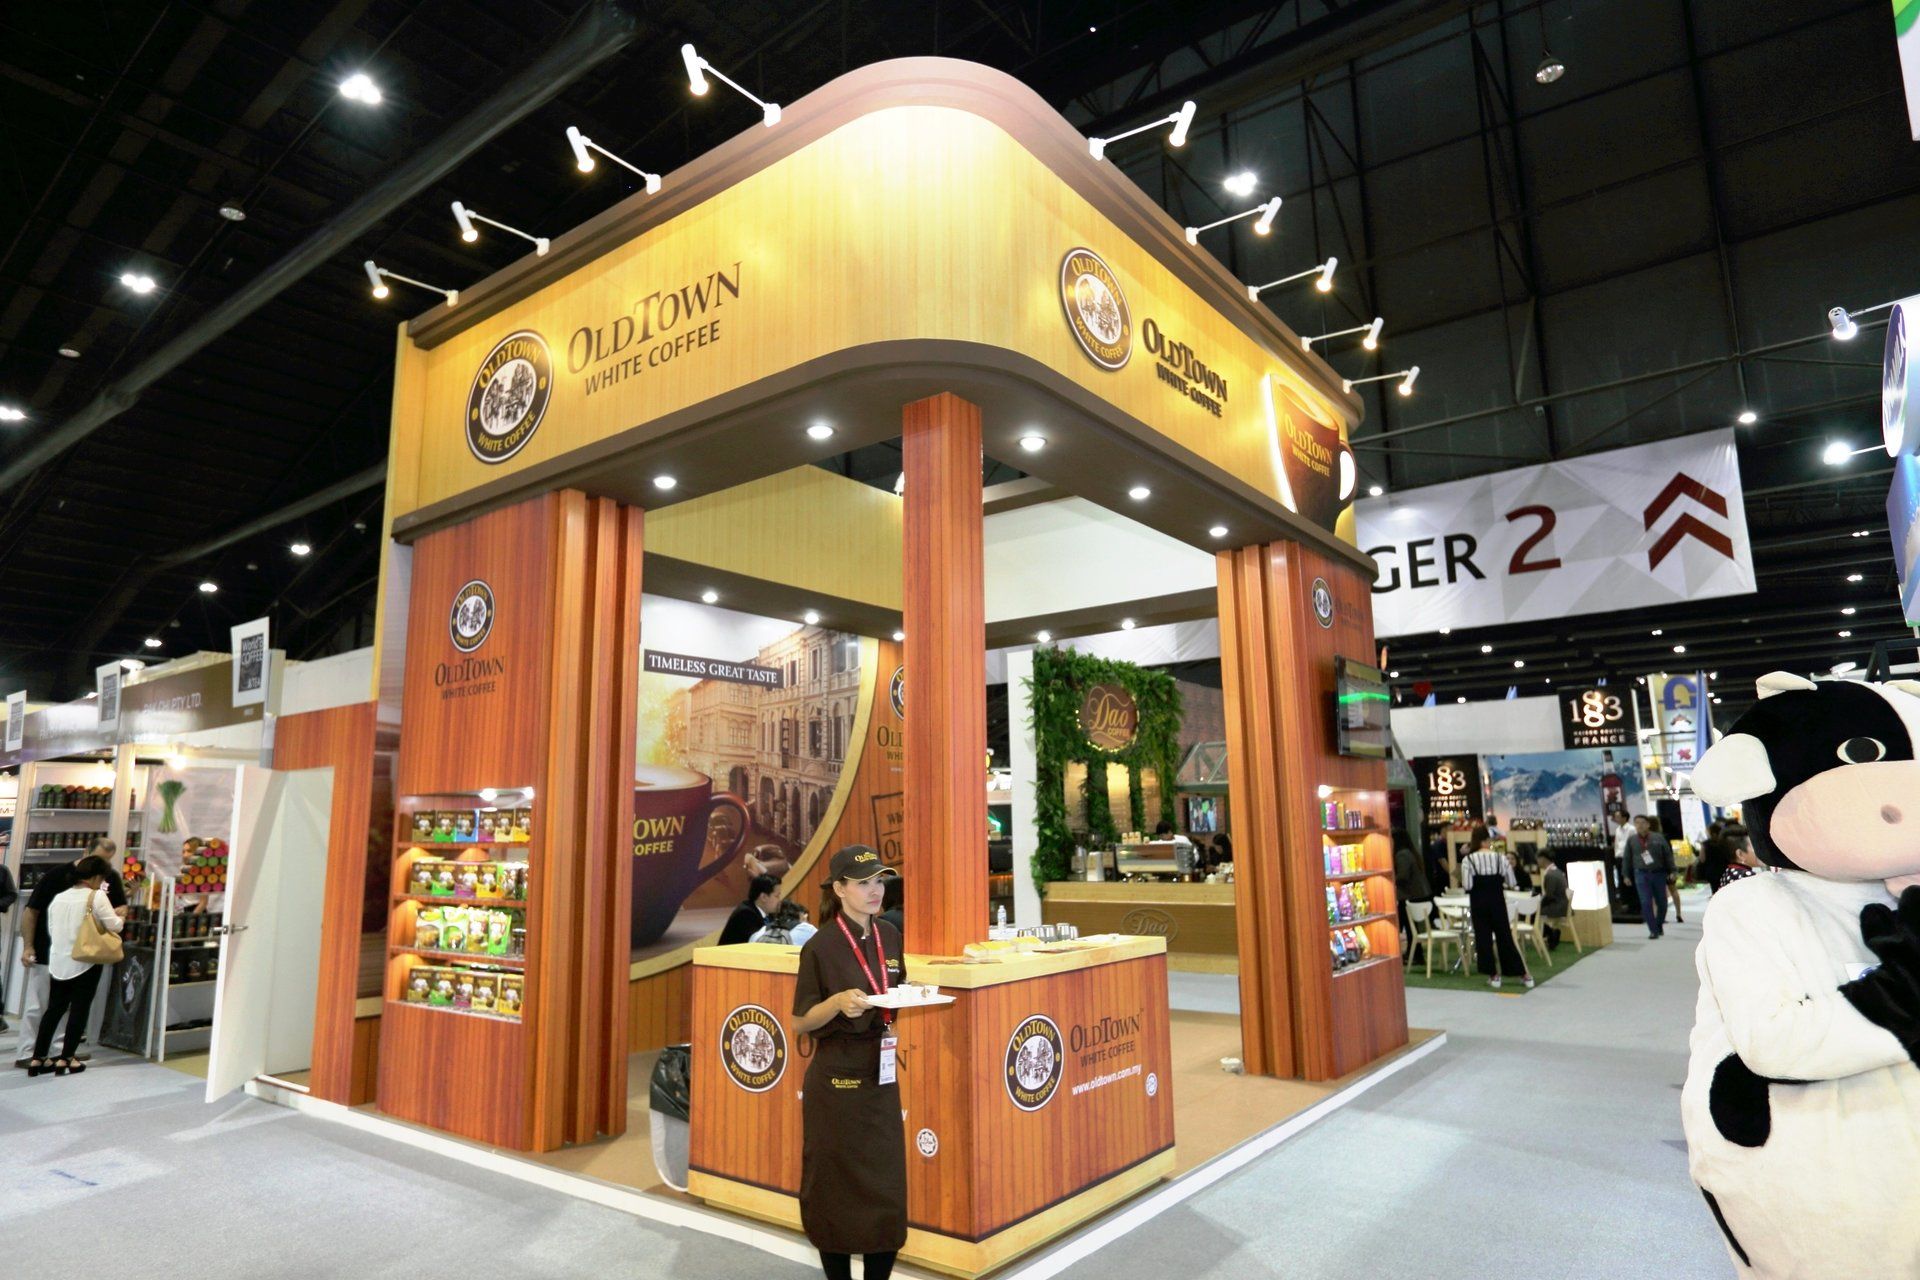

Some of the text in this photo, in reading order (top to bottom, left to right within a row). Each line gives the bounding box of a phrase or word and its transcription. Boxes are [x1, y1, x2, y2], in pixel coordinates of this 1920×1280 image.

[567, 261, 743, 374] OLDTOWN
[1075, 316, 1124, 359] WHITE COFFEE
[479, 340, 541, 388] OLDTOWN
[585, 319, 721, 396] WHITE COFFEE
[1143, 318, 1228, 402] OLDTOWN
[1156, 362, 1222, 418] WHITE COFFEE
[478, 410, 536, 452] WHITE COFFEE
[1285, 413, 1333, 465] OLDTOWN
[1291, 443, 1330, 477] WHITE COFFEE
[1505, 504, 1562, 575] 2
[435, 656, 504, 687] OLDTOWN
[649, 654, 778, 684] TIMELESS GREAT TASTE
[442, 681, 496, 700] WHITE COFFEE
[1574, 734, 1626, 745] FRANCE
[1430, 799, 1468, 808] FRANCE
[633, 814, 686, 840] OWN
[633, 840, 674, 856] OFFEE
[729, 1009, 778, 1036] OLDTOWN
[1012, 1020, 1056, 1052] OLDTOWN
[1070, 1014, 1141, 1053] OLDTOWN
[1080, 1041, 1136, 1067] WHITE COFFEE
[730, 1062, 777, 1085] WHITE COFFEE
[1072, 1064, 1142, 1096] www.oldtown.com.my
[1015, 1077, 1055, 1103] WHITE COFFEE
